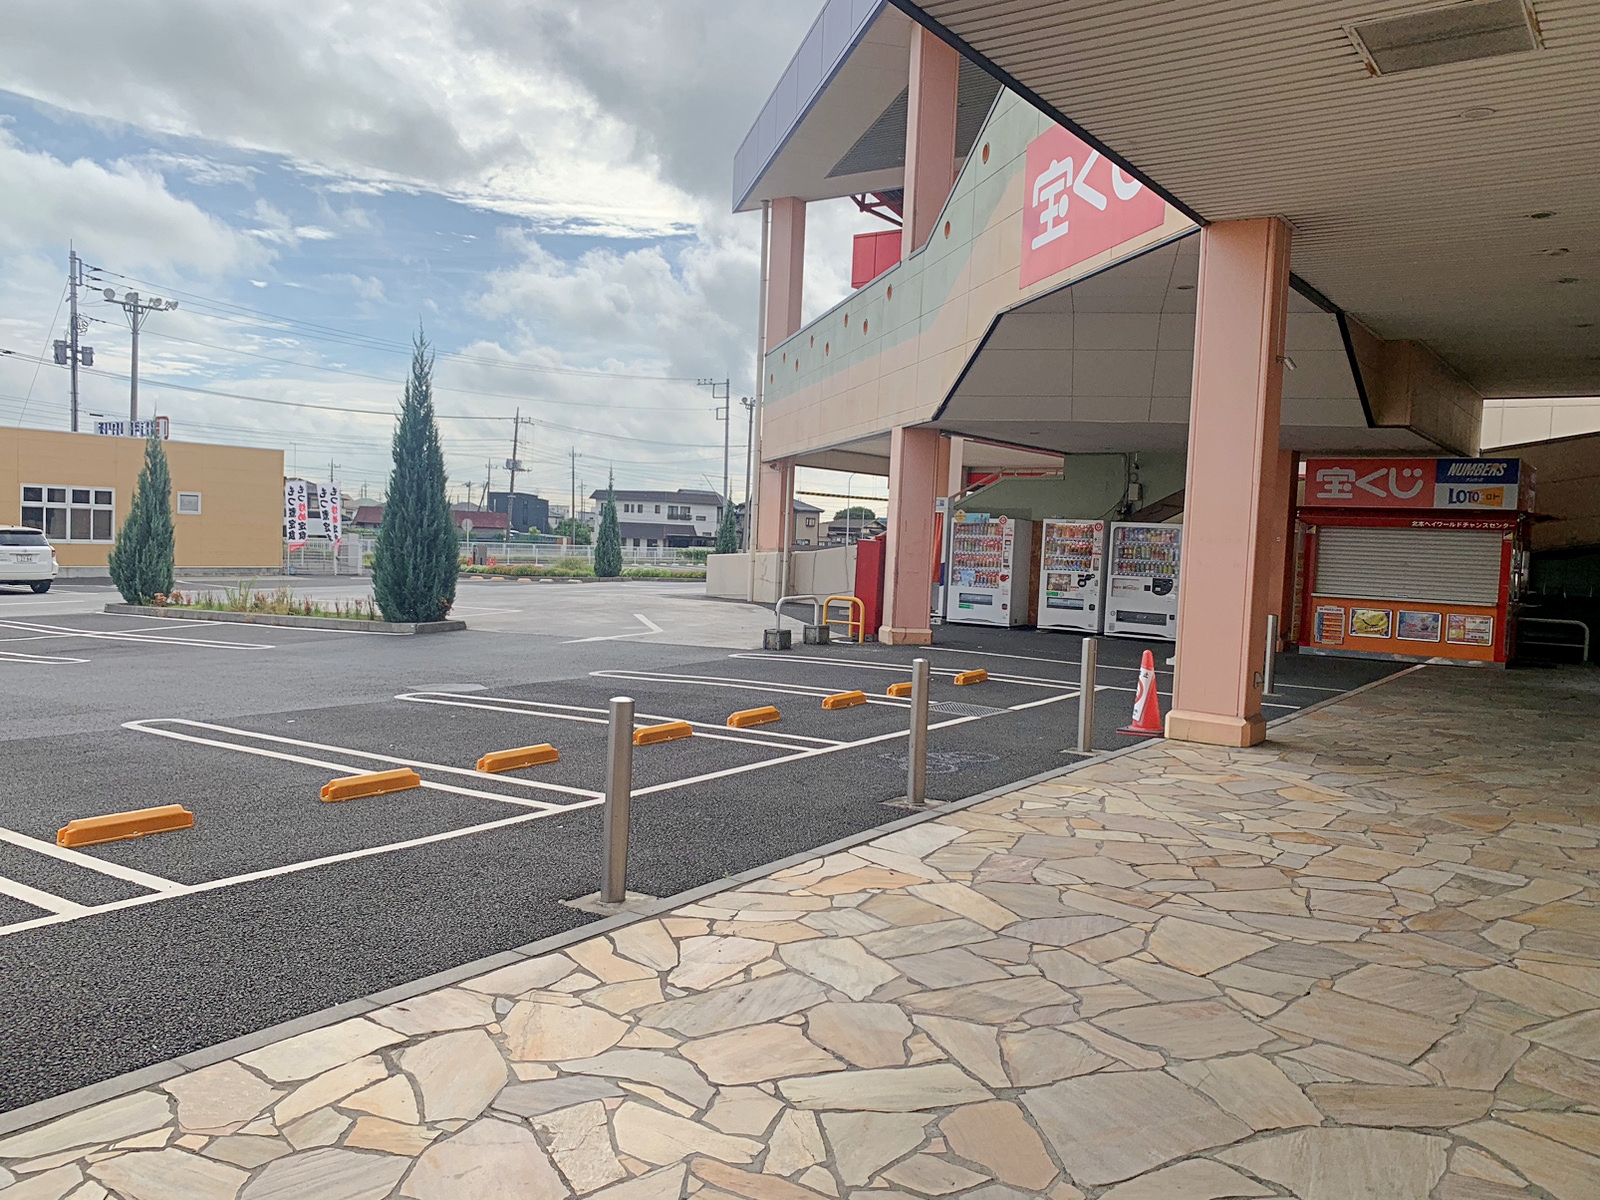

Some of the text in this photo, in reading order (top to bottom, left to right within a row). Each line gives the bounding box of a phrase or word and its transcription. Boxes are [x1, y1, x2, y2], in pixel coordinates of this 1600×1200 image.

[1447, 462, 1508, 477] NUMBERS
[1316, 466, 1424, 499] 宝くじ
[1448, 488, 1480, 504] LOTO
[1486, 493, 1501, 501] ロト
